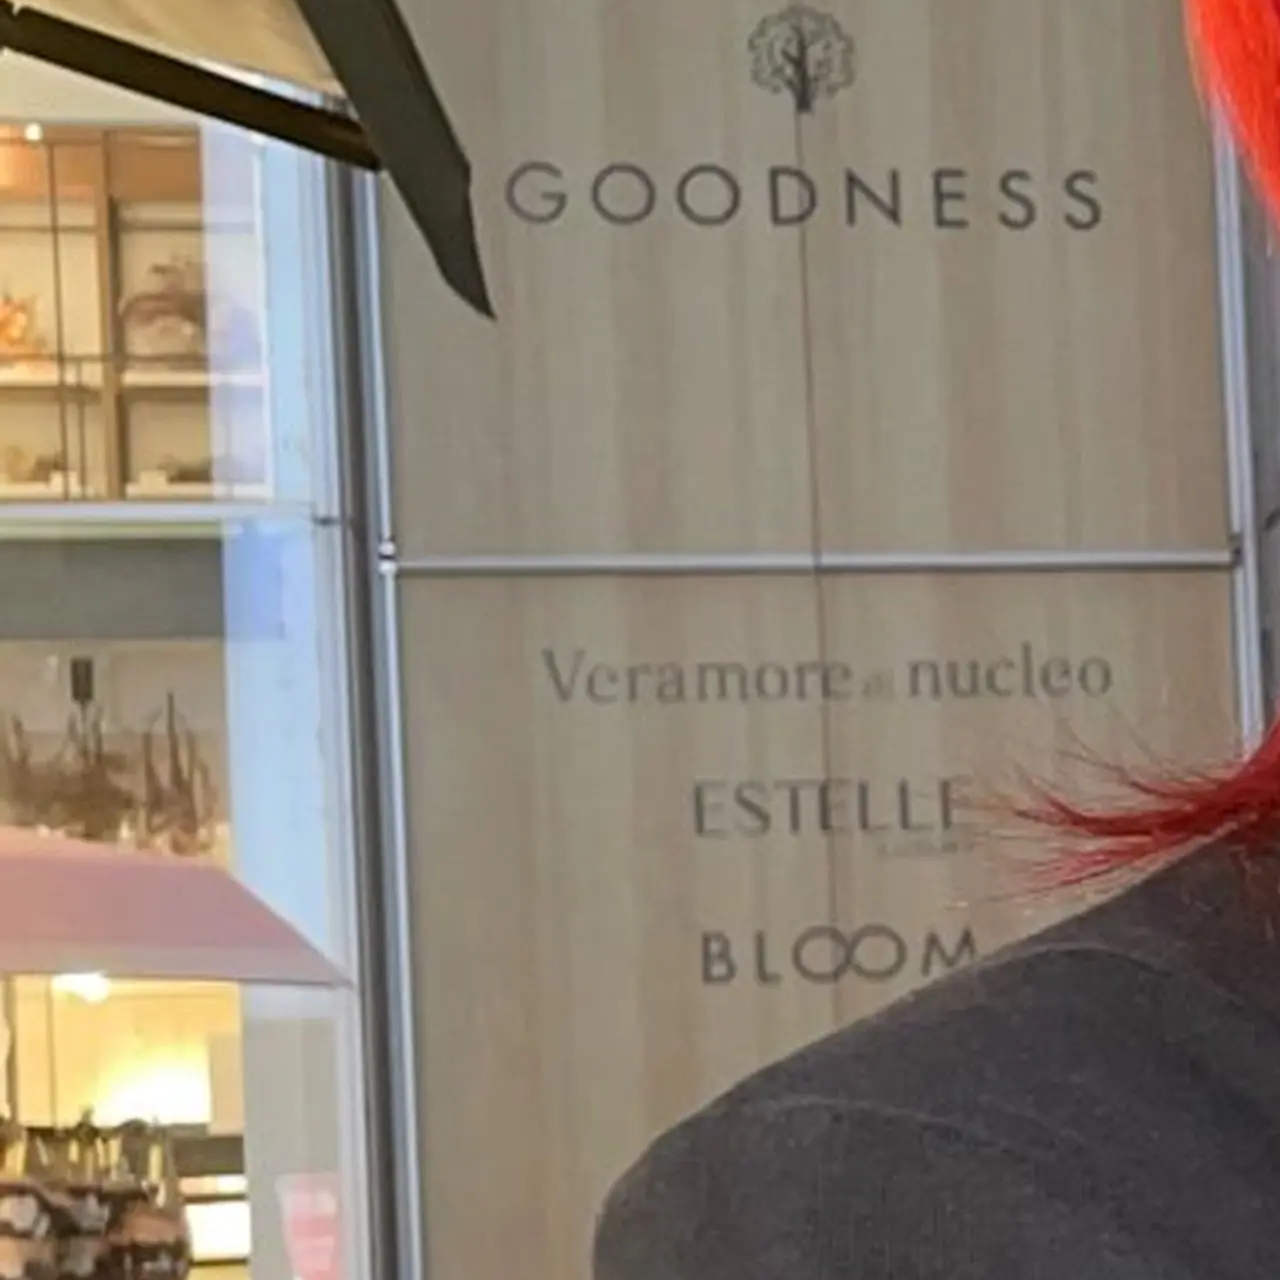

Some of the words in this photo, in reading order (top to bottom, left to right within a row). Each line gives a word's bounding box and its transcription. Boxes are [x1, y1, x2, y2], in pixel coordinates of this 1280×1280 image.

[504, 160, 1103, 231] GOODNESS
[541, 647, 854, 704] Veramore
[907, 641, 1113, 701] nucleo
[700, 924, 979, 987] BLOOM
